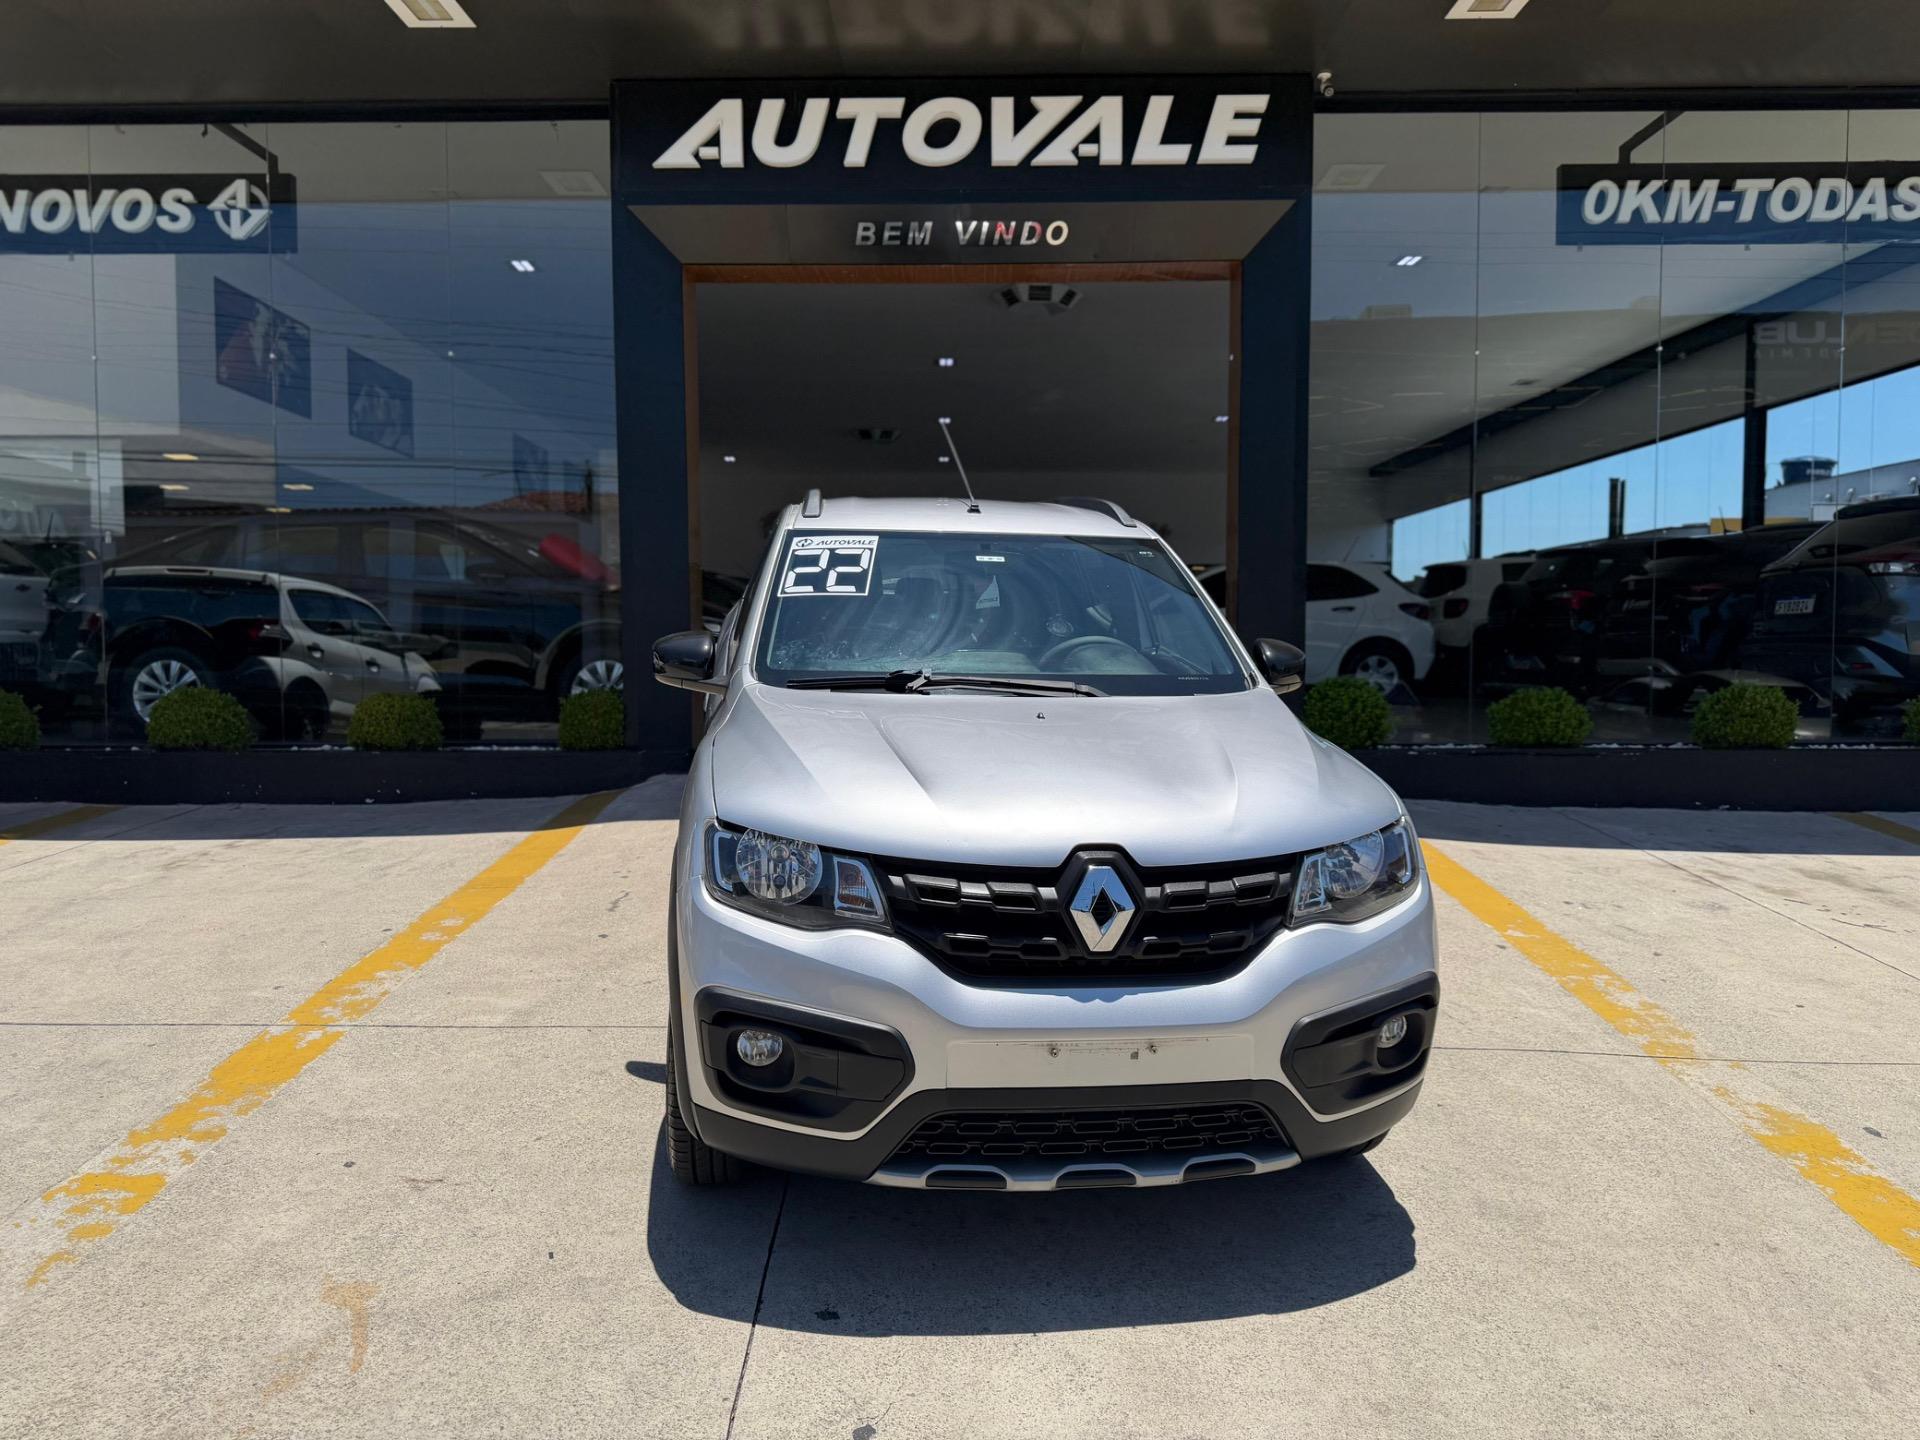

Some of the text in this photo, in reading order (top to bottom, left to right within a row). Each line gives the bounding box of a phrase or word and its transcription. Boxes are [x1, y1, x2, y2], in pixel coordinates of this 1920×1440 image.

[652, 94, 1270, 168] AUTOVALE
[855, 220, 1069, 246] BEM VINDO
[784, 548, 871, 593] 22
